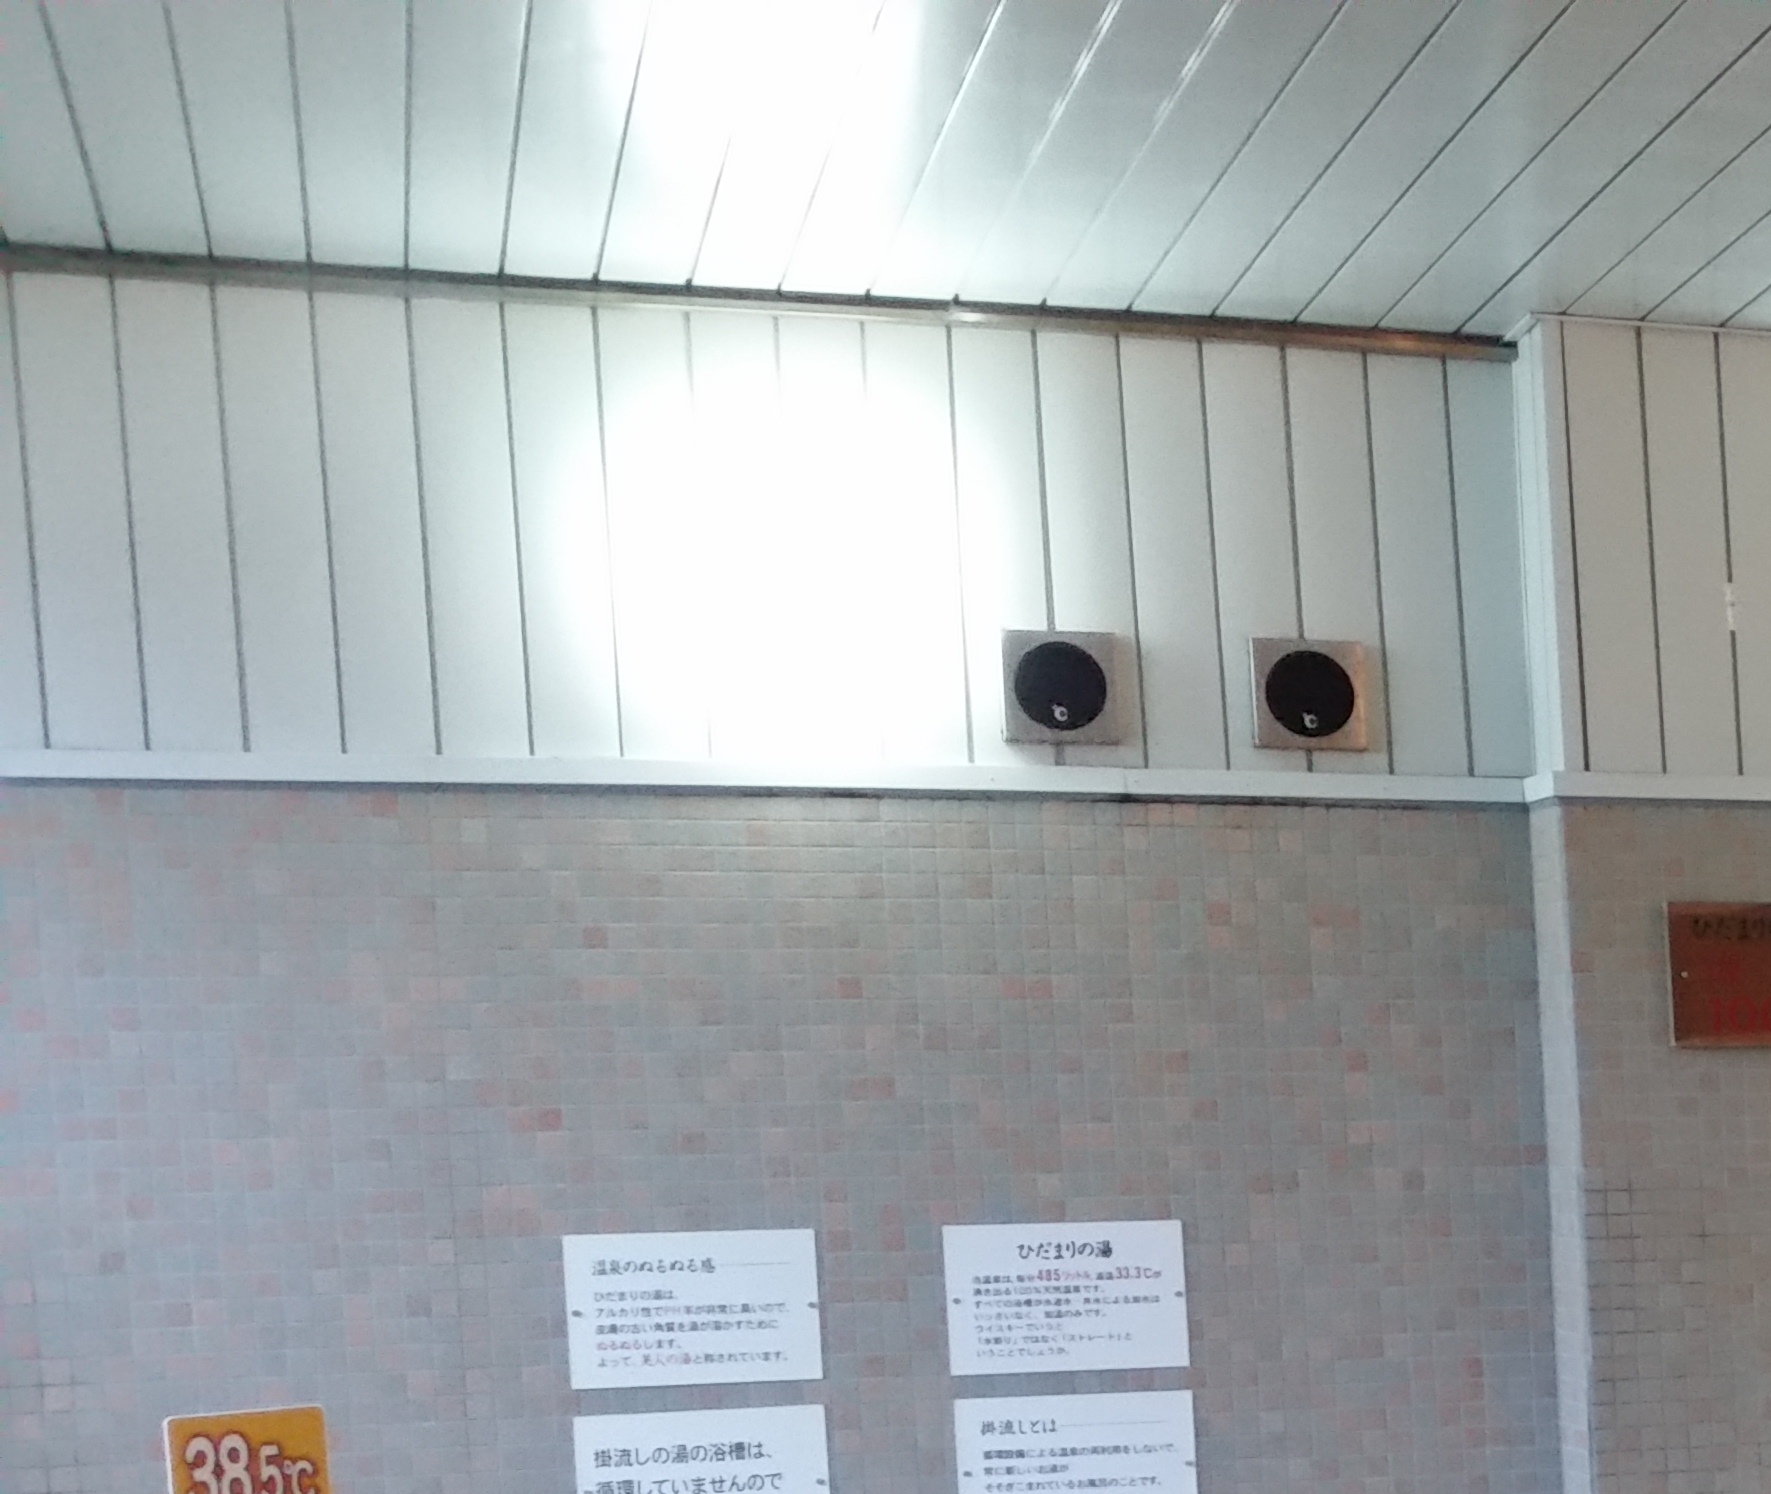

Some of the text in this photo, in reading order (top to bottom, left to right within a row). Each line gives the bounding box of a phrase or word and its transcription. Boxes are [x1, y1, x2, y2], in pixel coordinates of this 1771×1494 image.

[1016, 1239, 1114, 1260] ひだまりの湯
[591, 1257, 716, 1277] 温泉のぬるぬる感
[980, 1418, 1058, 1436] 掛流しとは
[593, 1441, 773, 1468] 掛流しの湯の浴槽は、
